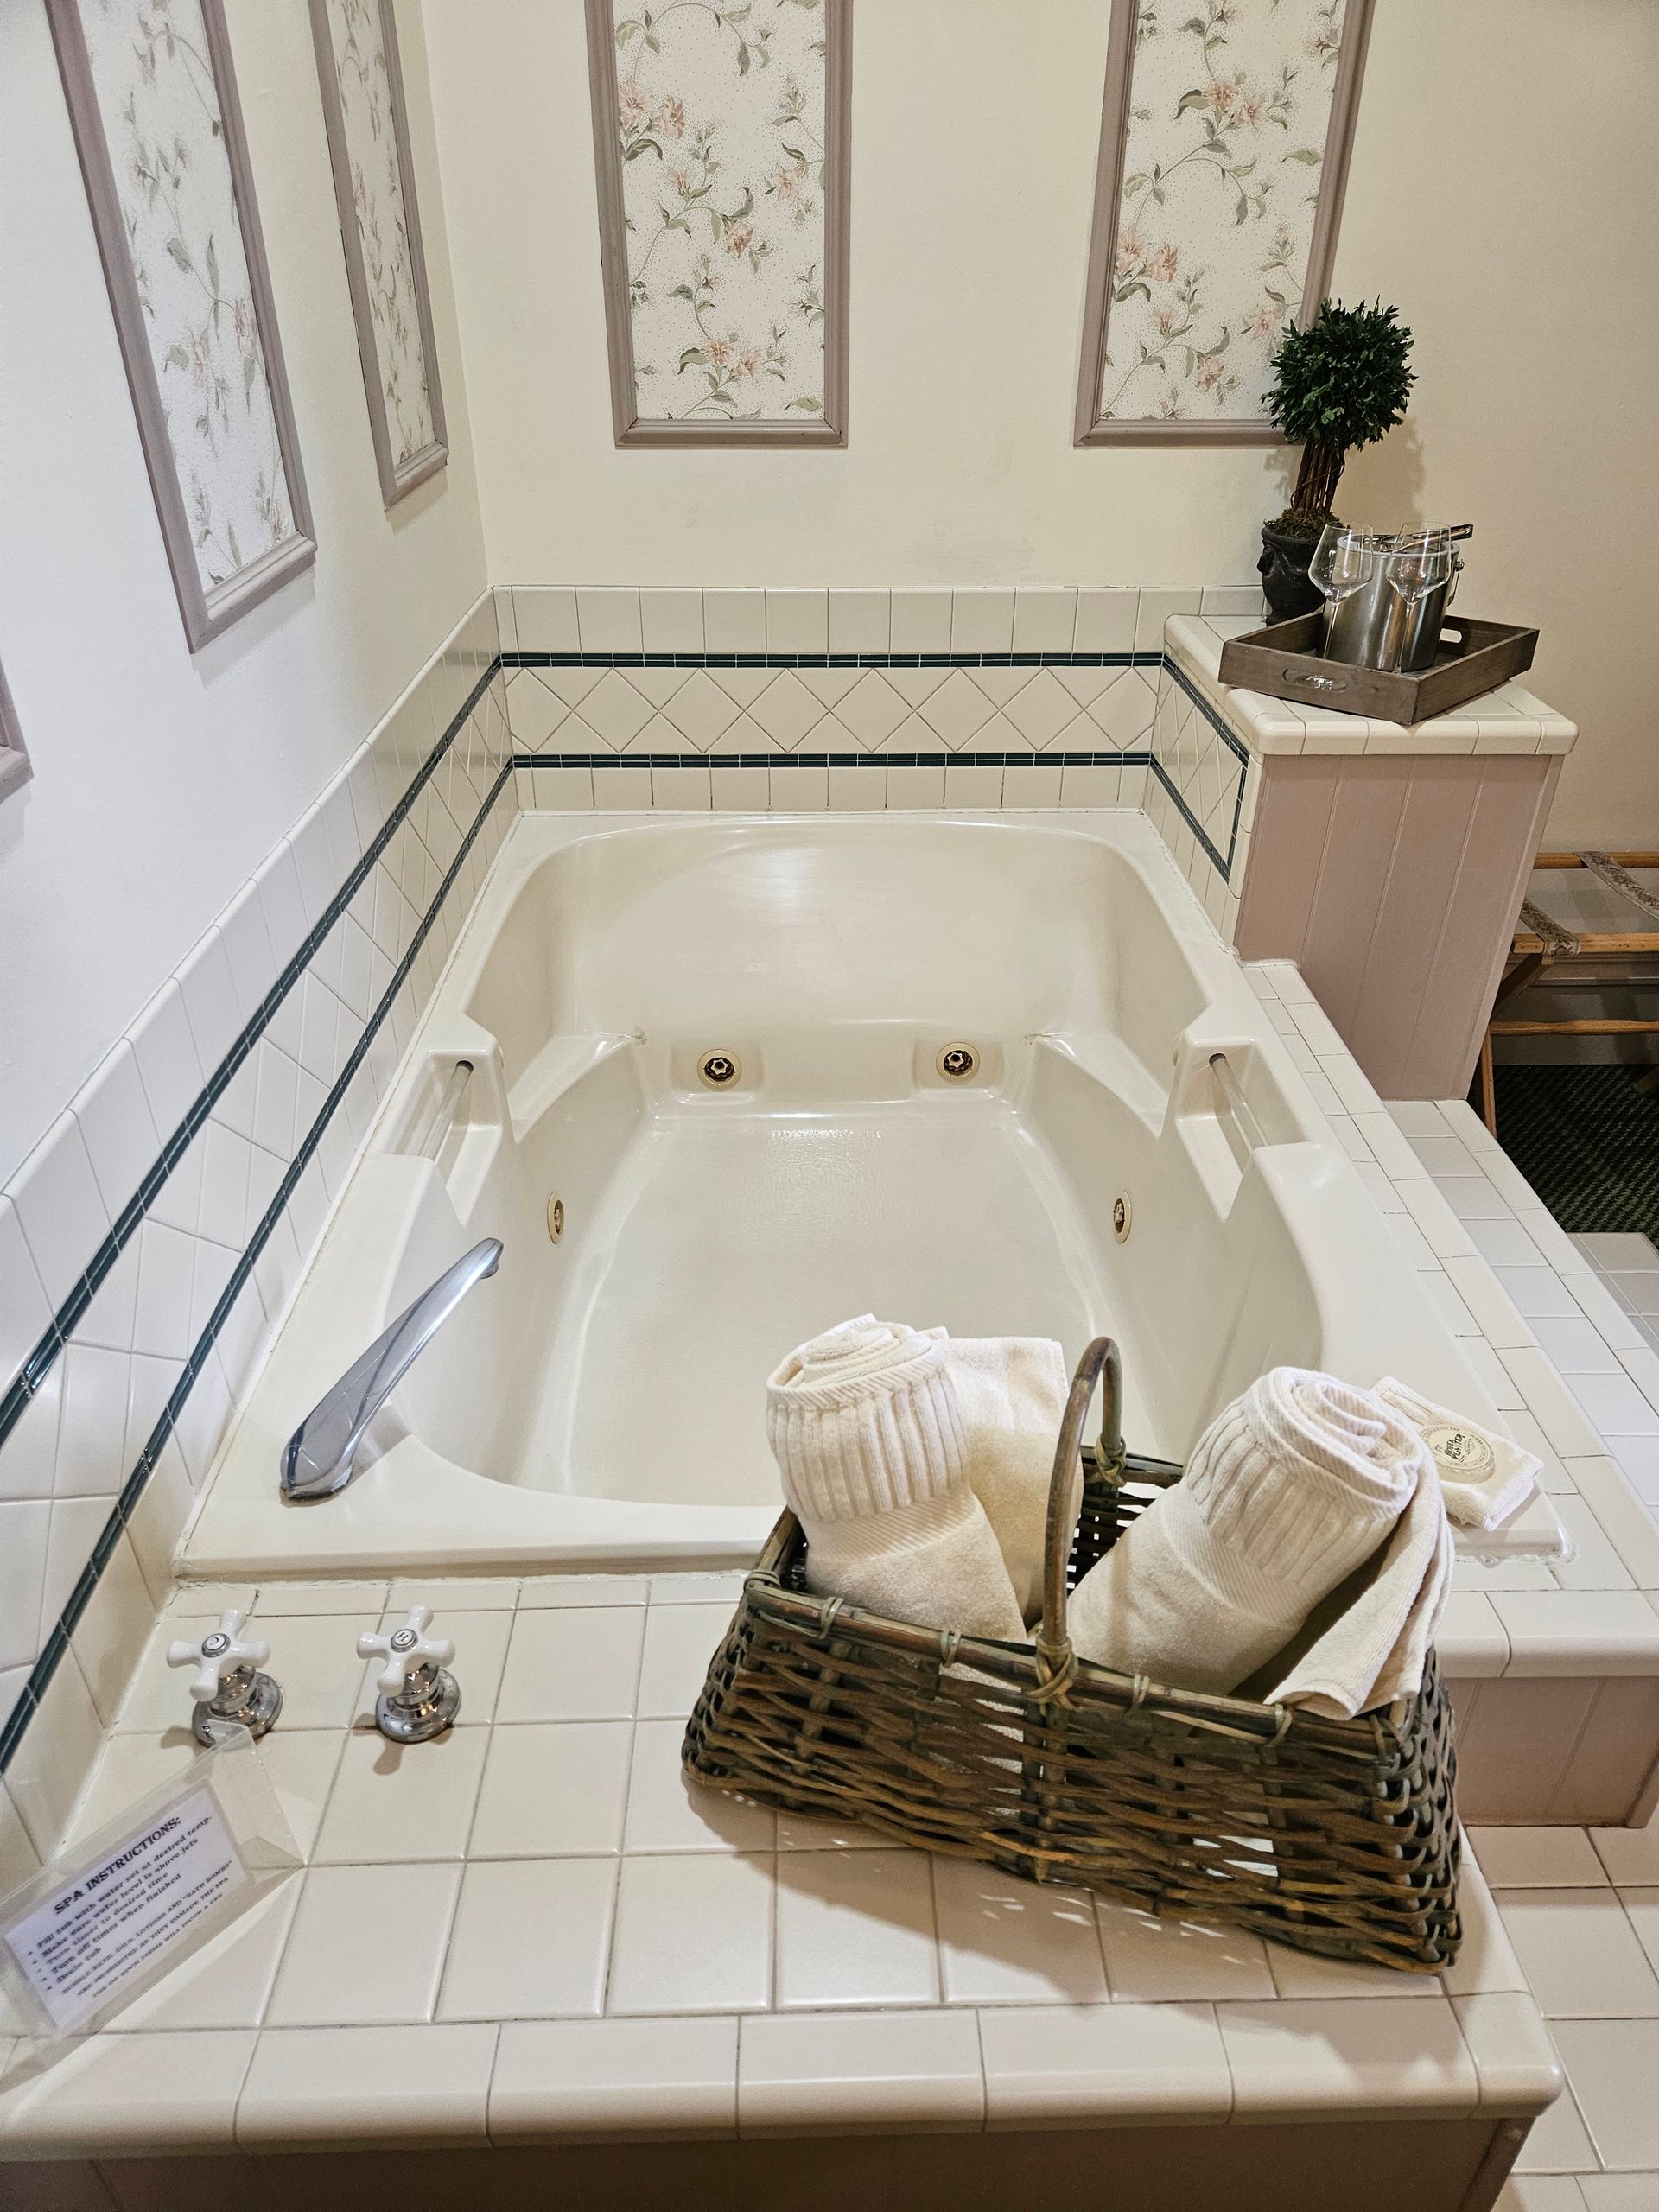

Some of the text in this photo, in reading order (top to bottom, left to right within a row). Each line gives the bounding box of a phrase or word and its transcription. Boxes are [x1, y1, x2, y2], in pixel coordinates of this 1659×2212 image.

[1444, 1439, 1454, 1457] HOTEL
[397, 1631, 409, 1642] H
[35, 1932, 54, 1948] Fill
[54, 1919, 73, 1934] tub
[74, 1902, 96, 1921] with
[97, 1881, 124, 1903] water
[124, 1868, 139, 1883] set
[152, 1834, 186, 1861] desired
[186, 1815, 213, 1836] temp.
[41, 1934, 68, 1958] Make
[69, 1918, 92, 1936] sure
[93, 1897, 119, 1919] water
[119, 1876, 145, 1898] level
[153, 1851, 181, 1872] above
[180, 1837, 199, 1855] jets
[53, 1815, 181, 1915] SPA INSTRUCTIONS:
[46, 1945, 71, 1966] Turn
[71, 1923, 99, 1946] timer
[112, 1888, 146, 1916] desired
[147, 1871, 168, 1889] time
[50, 1872, 181, 1974] Turn off timer when finished
[55, 1946, 101, 1984] Drain tub
[92, 1947, 138, 1983] PROHIBITED
[149, 1923, 169, 1939] THEY
[169, 1899, 200, 1923] DAMAGE
[200, 1887, 214, 1900] THE
[214, 1876, 228, 1888] SPA
[134, 1910, 167, 1937] LOTIONS
[167, 1899, 182, 1912] AND
[163, 1927, 181, 1942] WILL
